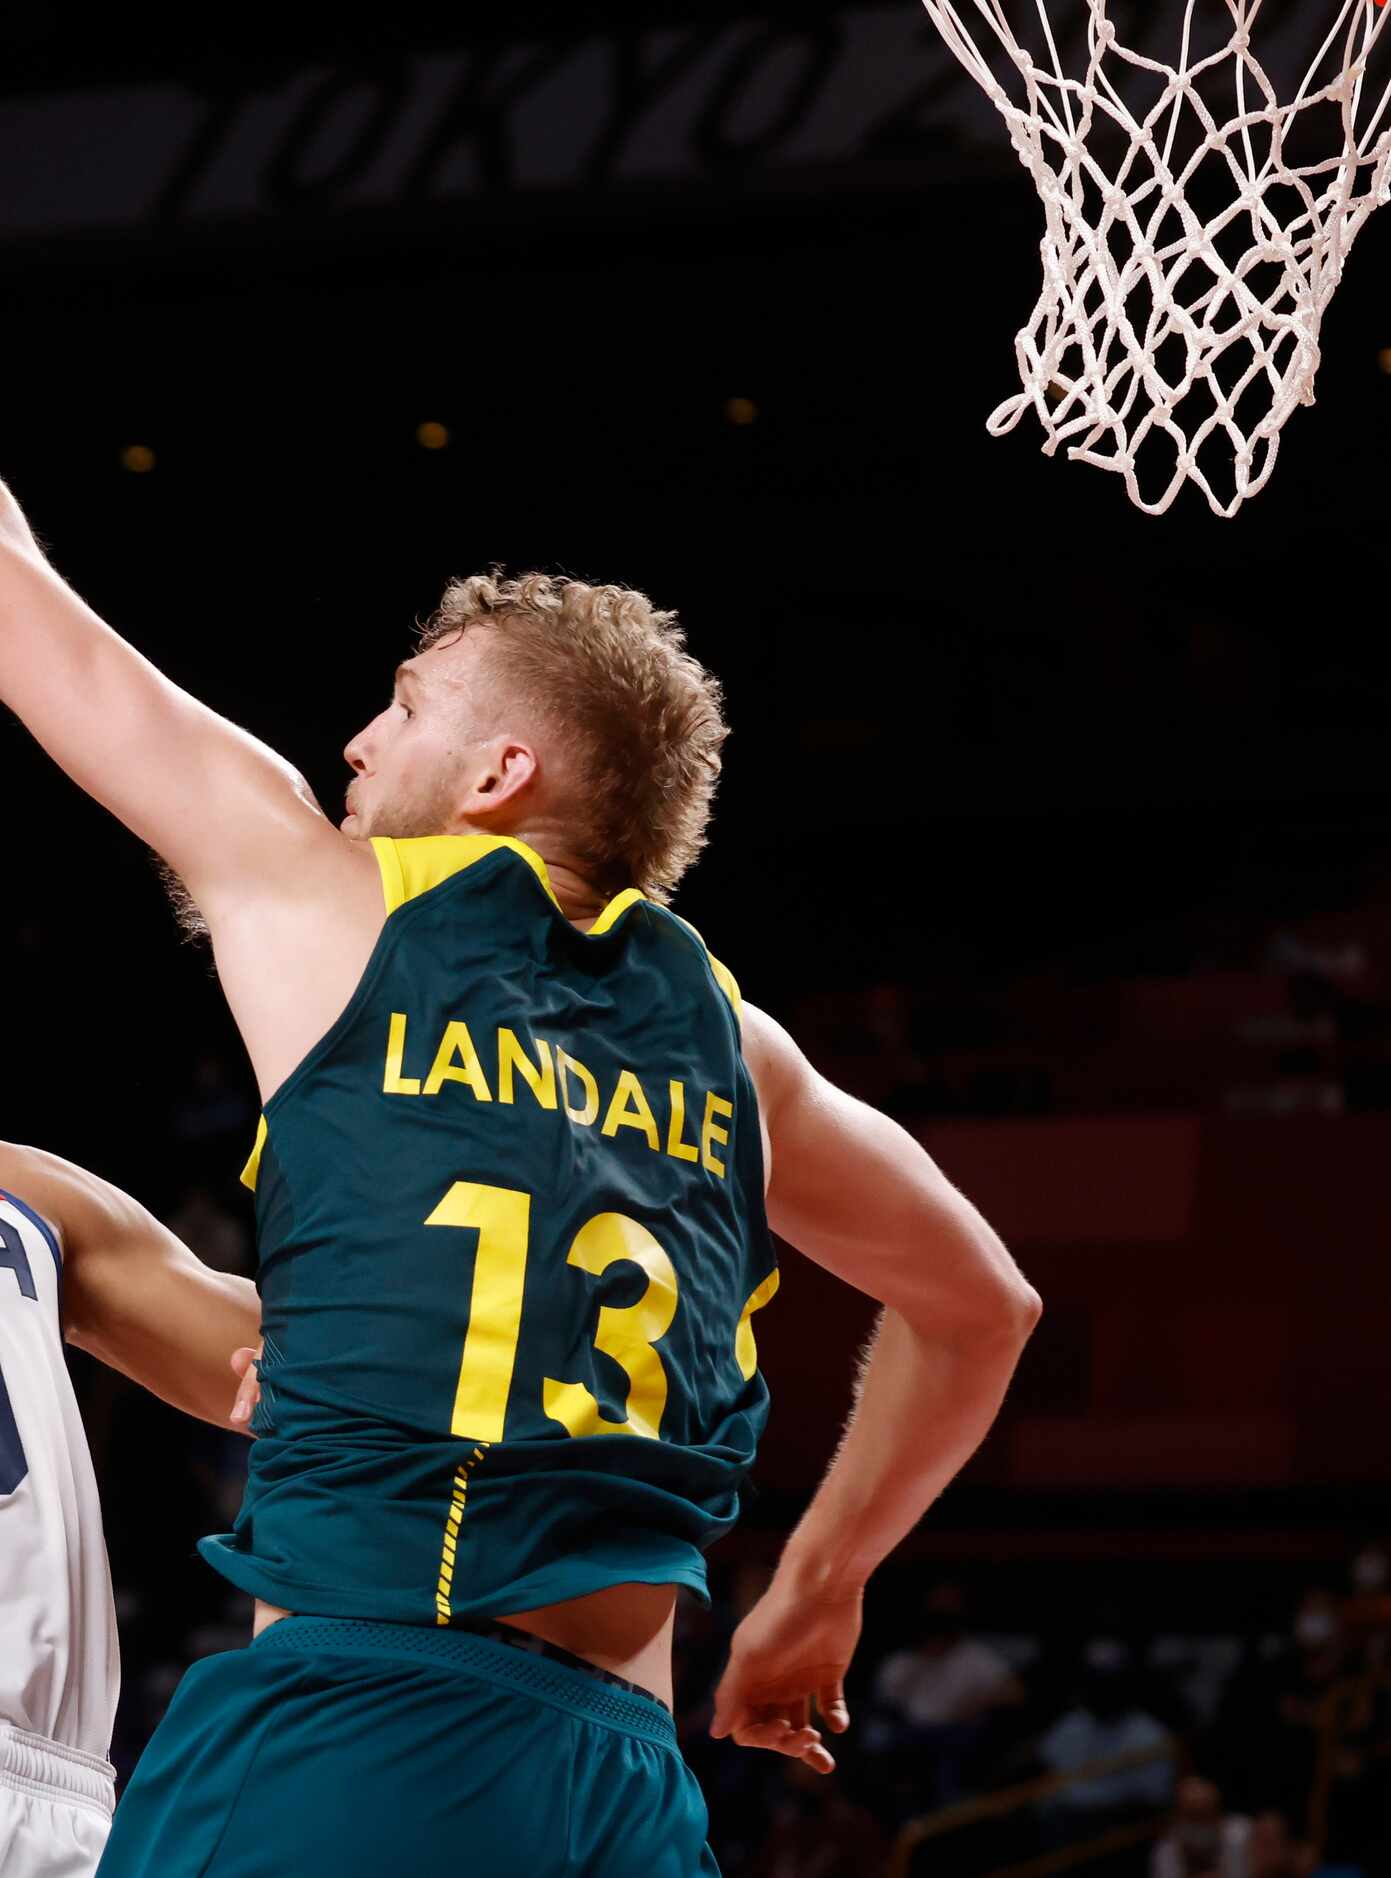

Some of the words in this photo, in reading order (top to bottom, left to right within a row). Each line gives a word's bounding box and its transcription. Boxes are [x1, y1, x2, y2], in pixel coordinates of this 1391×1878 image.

[150, 16, 844, 218] TOKYO
[383, 1012, 733, 1179] LANDALE
[424, 1180, 678, 1443] 13
